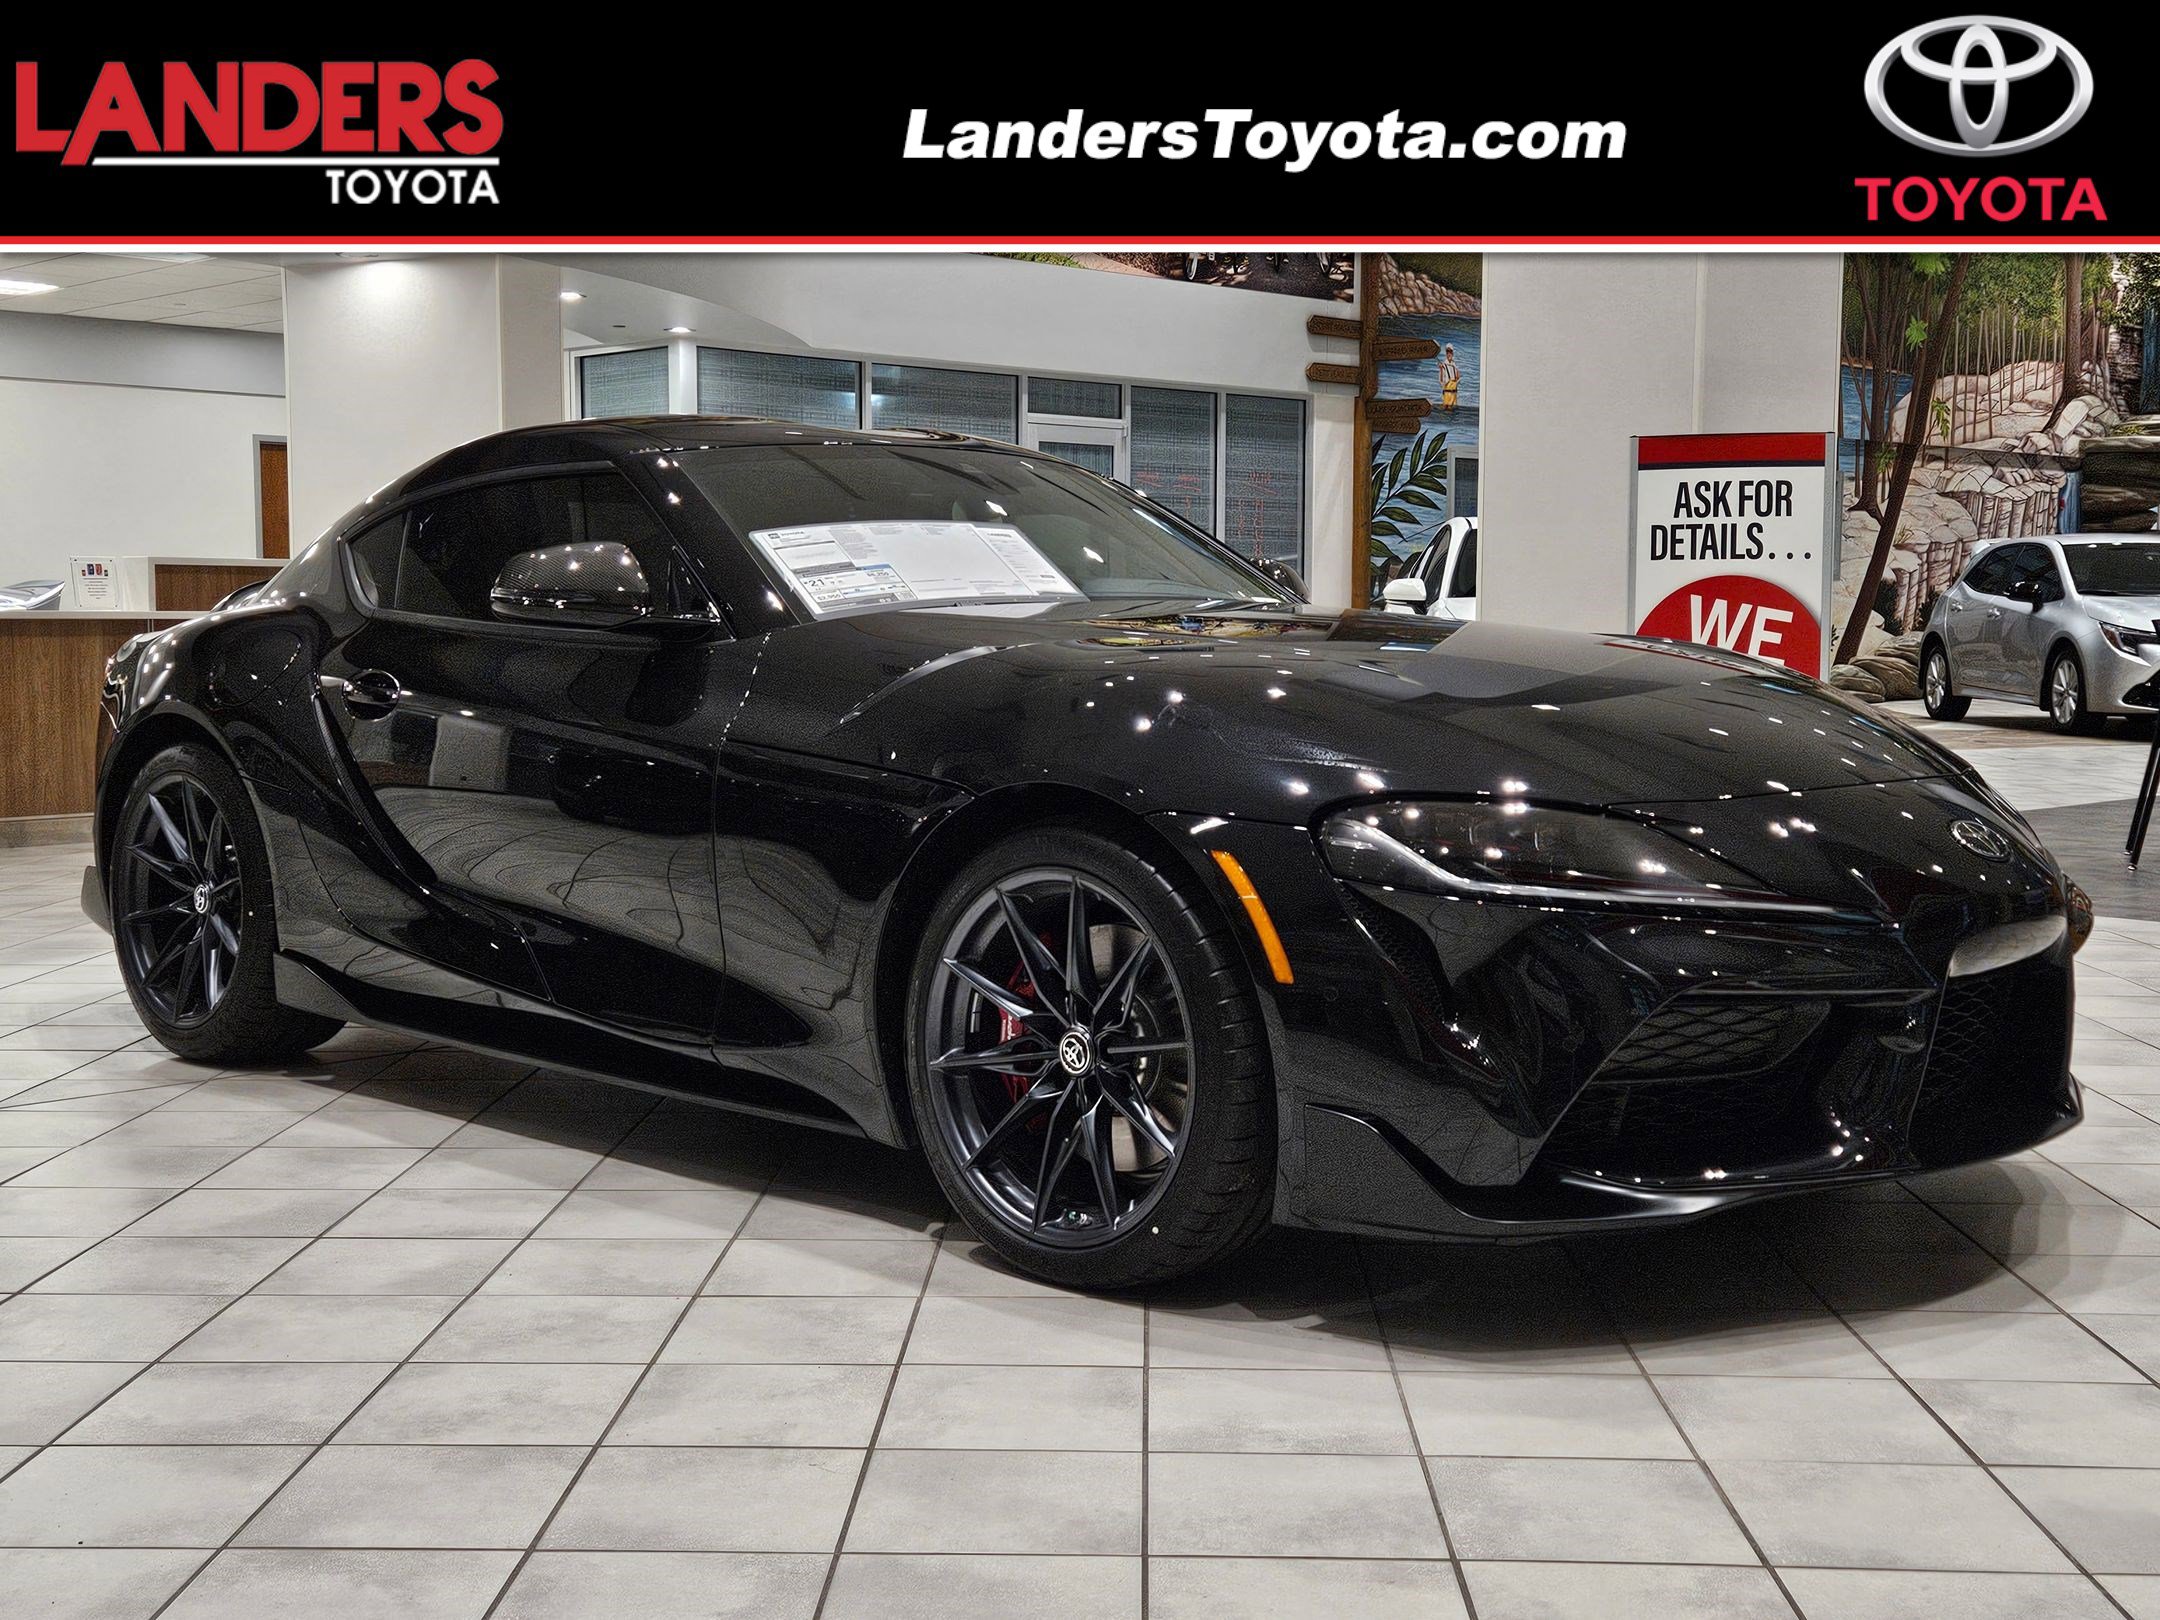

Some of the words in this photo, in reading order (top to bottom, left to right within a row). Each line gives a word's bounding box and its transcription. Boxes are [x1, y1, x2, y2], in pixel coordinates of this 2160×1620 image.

[1673, 481, 1732, 518] ASK
[1738, 480, 1793, 517] FOR
[1690, 594, 1794, 666] WE
